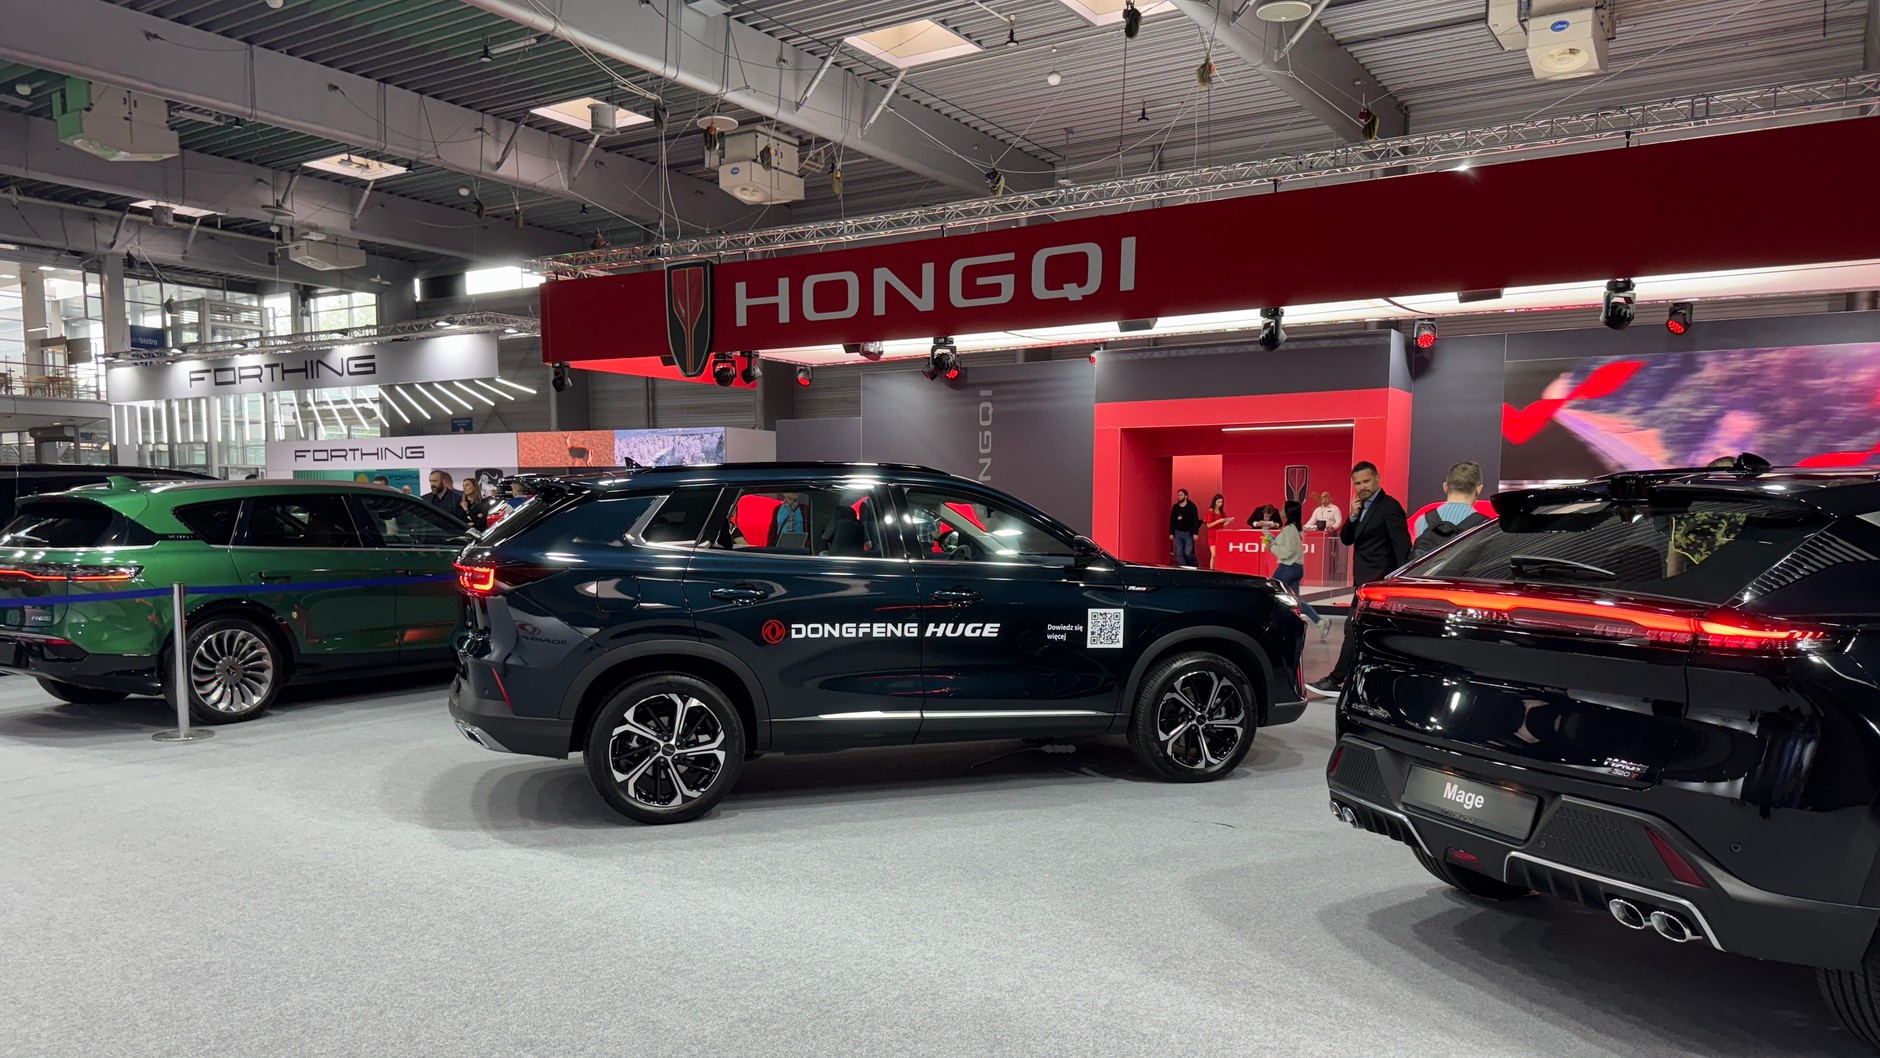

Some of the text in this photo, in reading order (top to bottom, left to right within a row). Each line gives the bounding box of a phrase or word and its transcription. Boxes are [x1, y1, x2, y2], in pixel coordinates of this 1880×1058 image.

[735, 236, 1136, 327] HONGQI
[189, 354, 376, 388] FORTHING
[978, 390, 993, 481] NGQI
[294, 446, 425, 462] FORTHING
[791, 623, 1000, 639] DONGFENG HUGE
[1046, 633, 1067, 641] więcej
[1074, 624, 1084, 633] się
[1443, 782, 1485, 809] Mage
